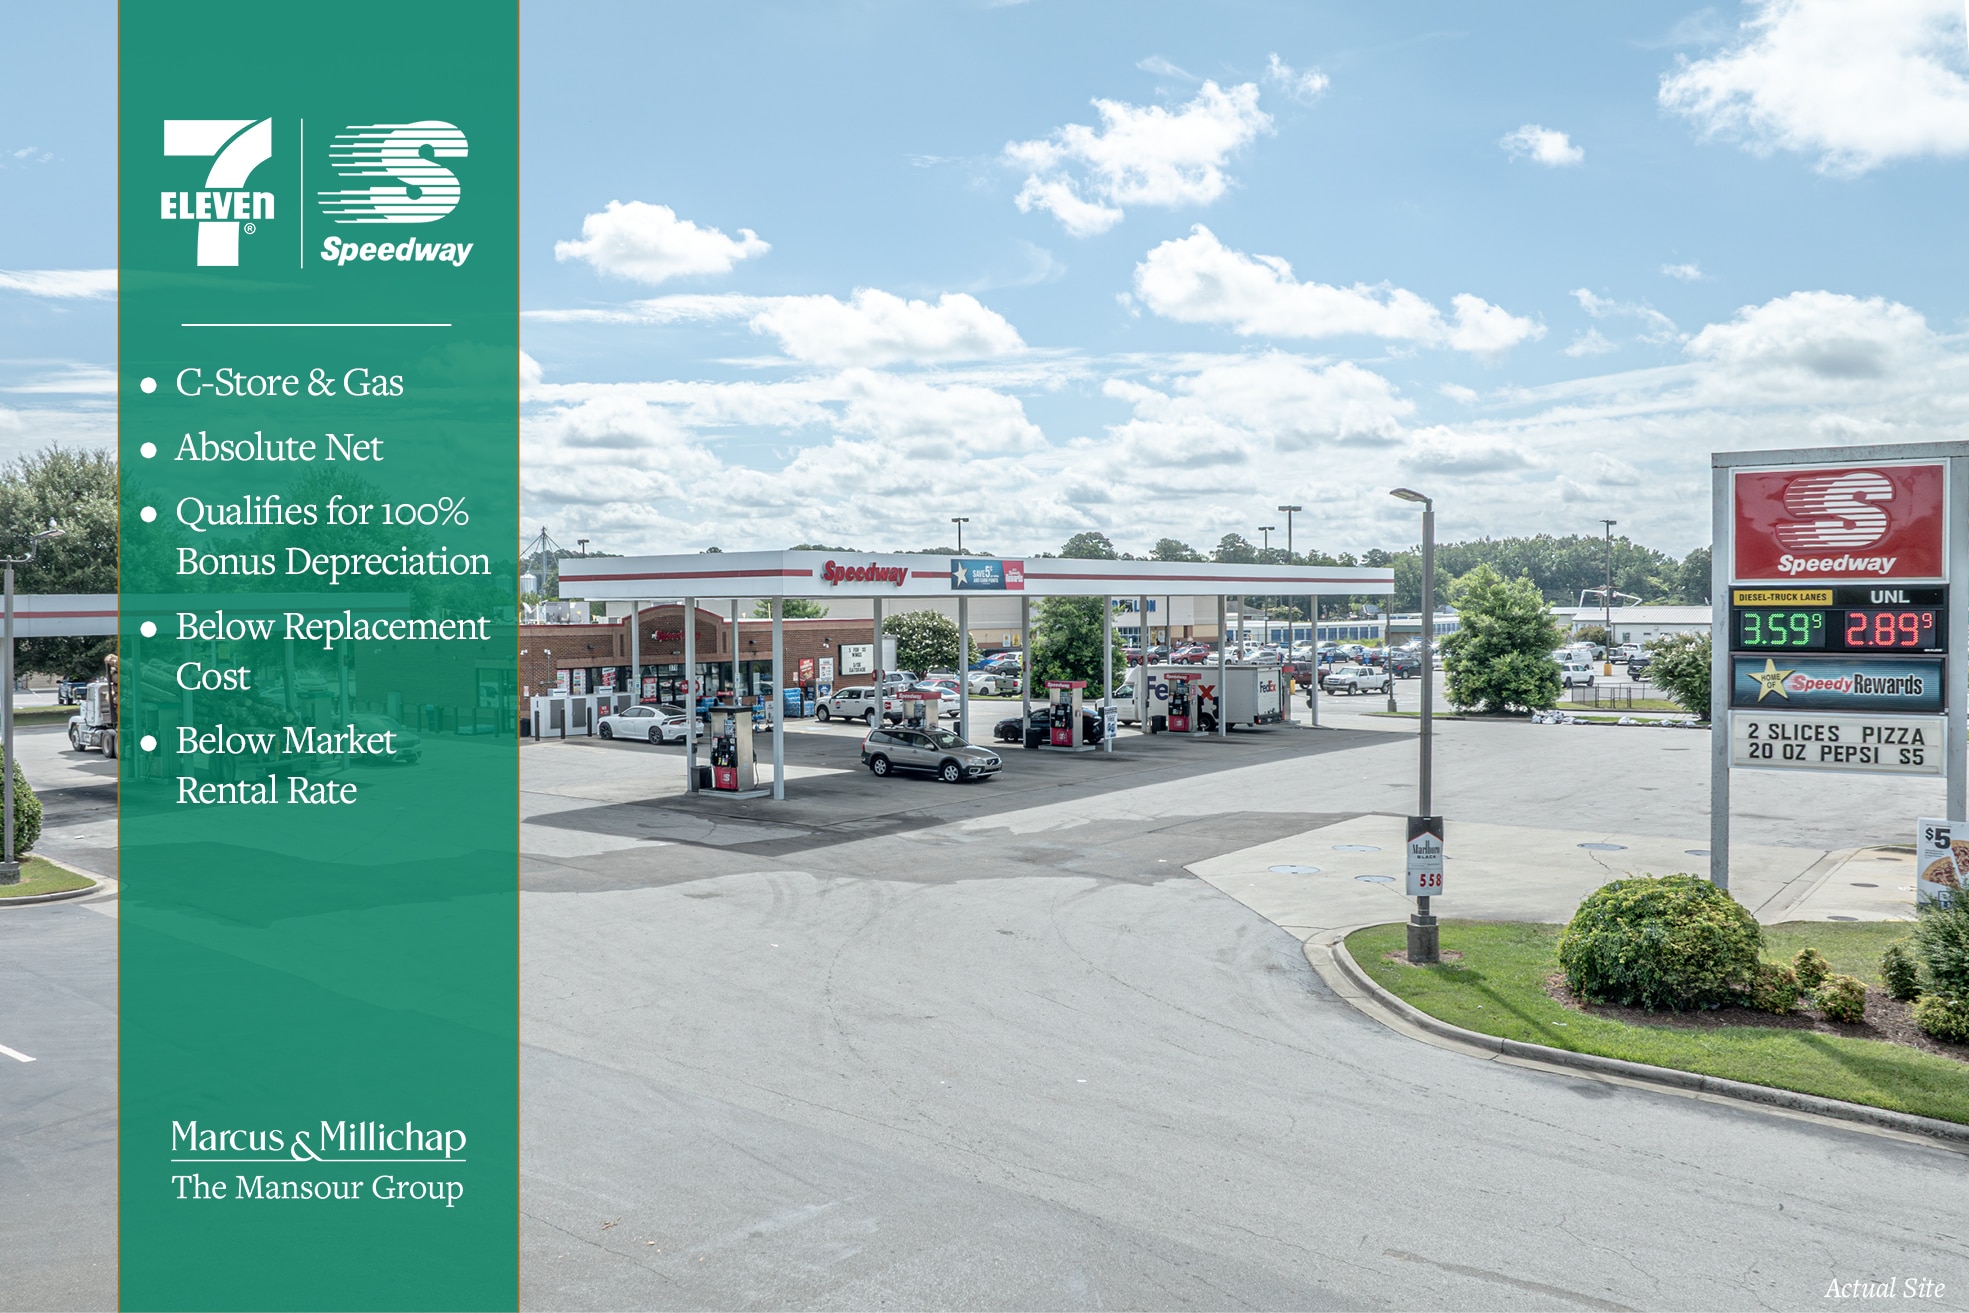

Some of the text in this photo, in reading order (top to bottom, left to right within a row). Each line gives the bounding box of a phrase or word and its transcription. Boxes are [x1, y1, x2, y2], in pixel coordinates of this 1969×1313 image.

[823, 559, 909, 587] Speedway
[972, 569, 985, 578] SAVE
[1777, 553, 1897, 576] Speedway
[1739, 590, 1910, 604] DIESEL-TRUCK LANES UNL
[1260, 679, 1277, 693] FedEx
[1761, 672, 1781, 681] HOME
[1766, 681, 1777, 689] OF
[1790, 673, 1923, 696] Speedy Rewards
[1147, 675, 1216, 701] Fex
[1748, 723, 1925, 746] 2 SLICES PIZZA
[1748, 743, 1773, 759] 20
[1782, 743, 1806, 761] OZ
[1820, 745, 1879, 764] PEPSI
[1412, 840, 1440, 854] Marlboro
[1925, 827, 1951, 849] $5
